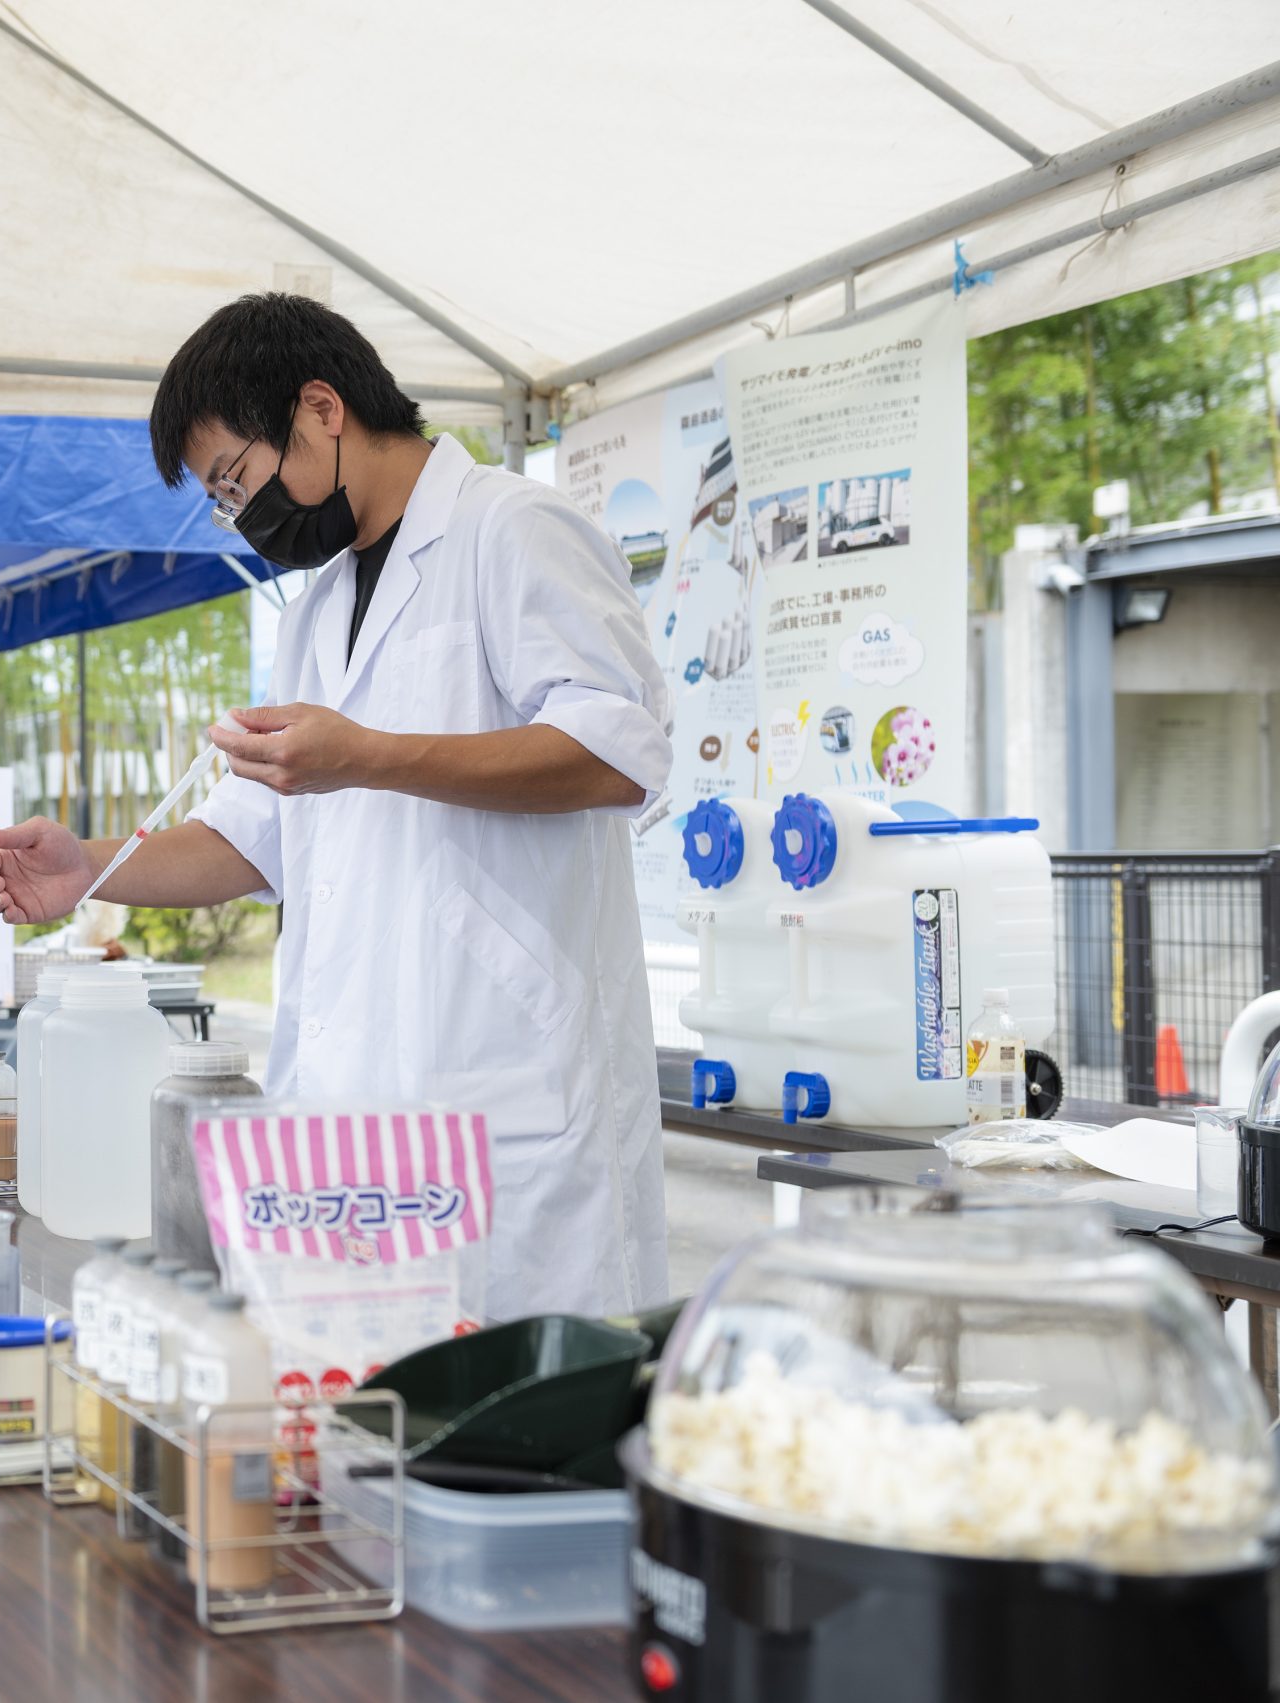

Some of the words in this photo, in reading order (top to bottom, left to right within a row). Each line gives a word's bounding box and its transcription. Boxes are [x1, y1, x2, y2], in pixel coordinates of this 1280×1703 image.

[863, 628, 891, 644] GAS
[780, 914, 804, 928] 焼酎粕
[916, 920, 940, 977] Tank
[916, 982, 939, 1079] Washable
[248, 1187, 461, 1226] ポップコーン
